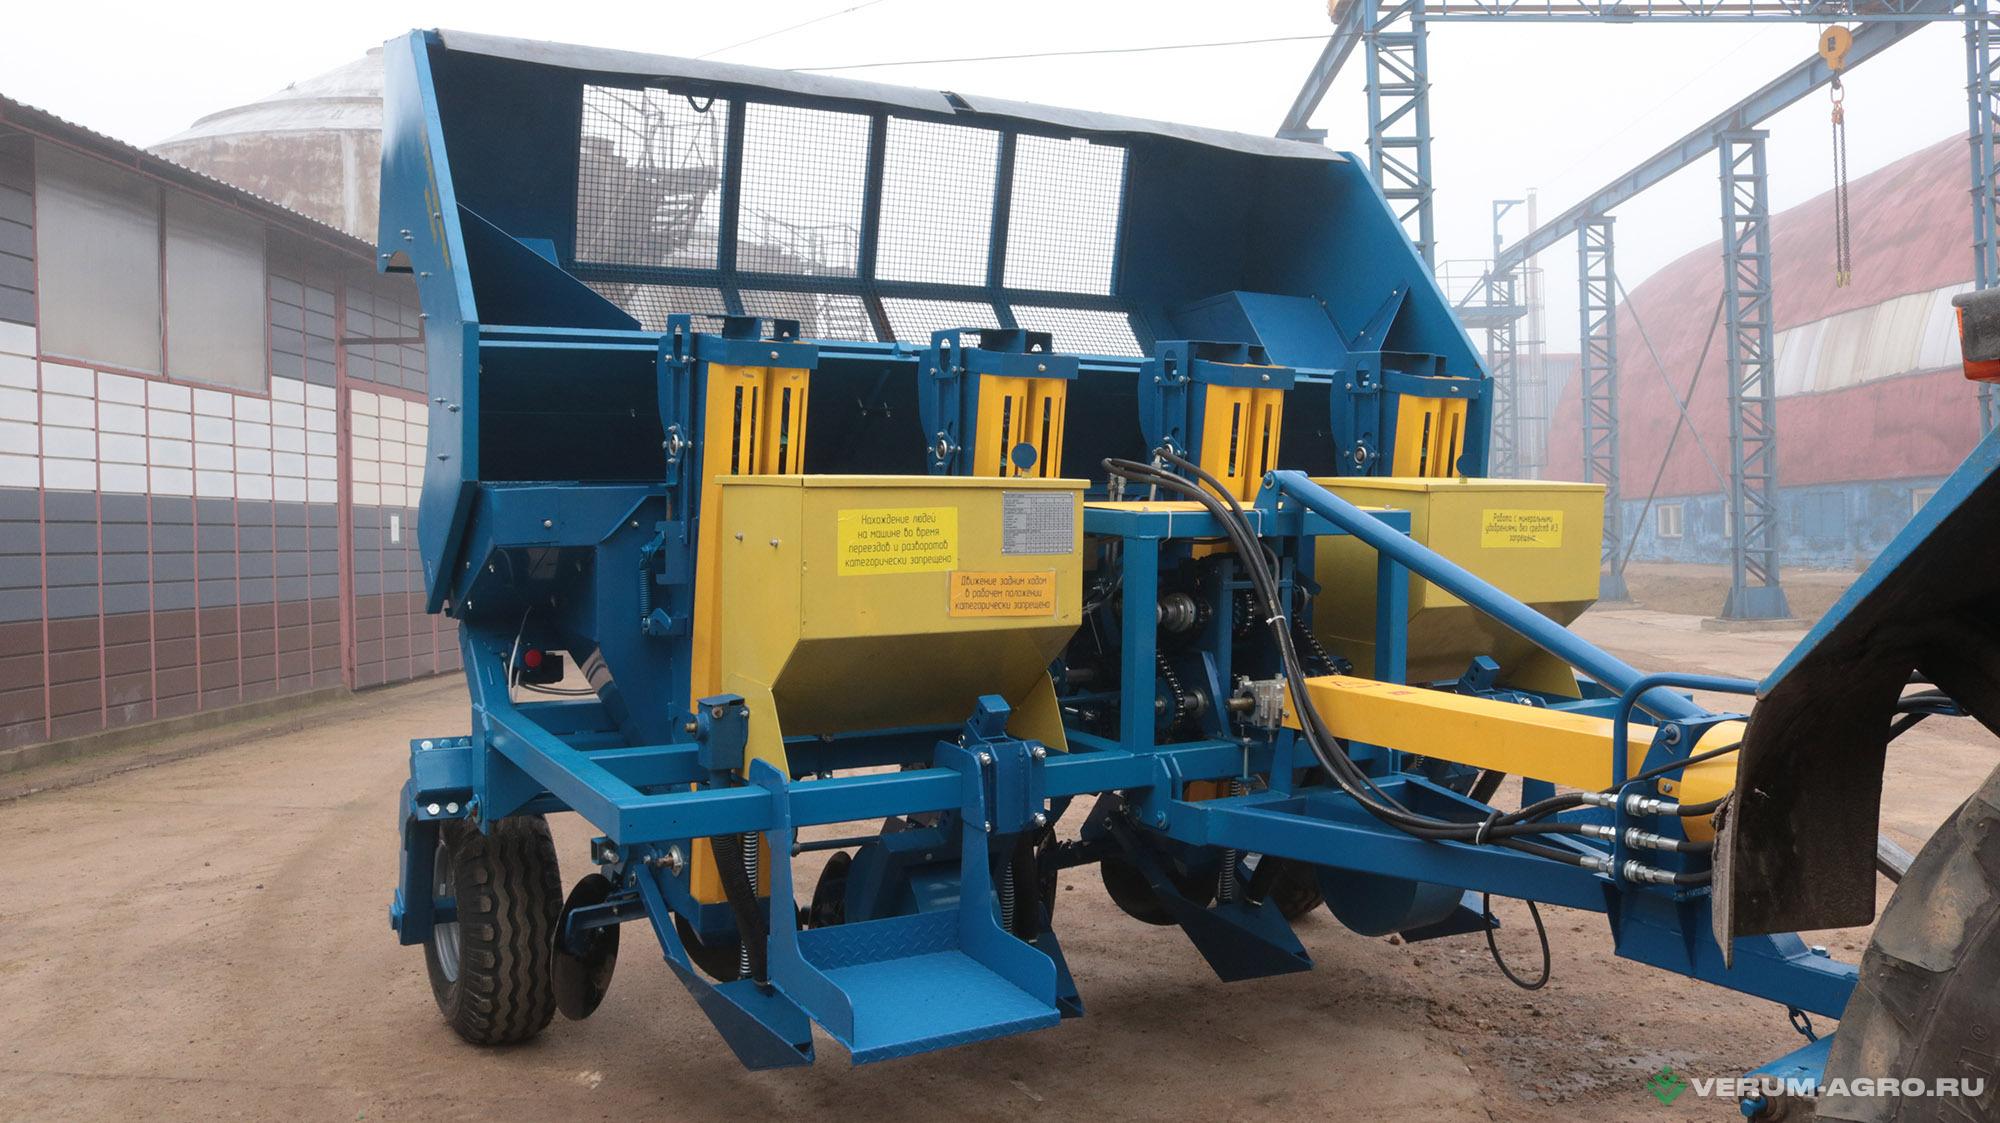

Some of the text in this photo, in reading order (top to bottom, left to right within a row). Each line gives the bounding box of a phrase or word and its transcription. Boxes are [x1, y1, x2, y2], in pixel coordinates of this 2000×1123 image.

[861, 512, 936, 525] Нахождение людей
[857, 527, 940, 539] на машине во время
[848, 540, 949, 555] переездов и разворотов
[845, 555, 952, 568] категорически запрещено
[961, 575, 1047, 586] Движение задним ходом
[965, 588, 1042, 599] в рабочем положении
[955, 601, 1051, 612] категорически запрещено
